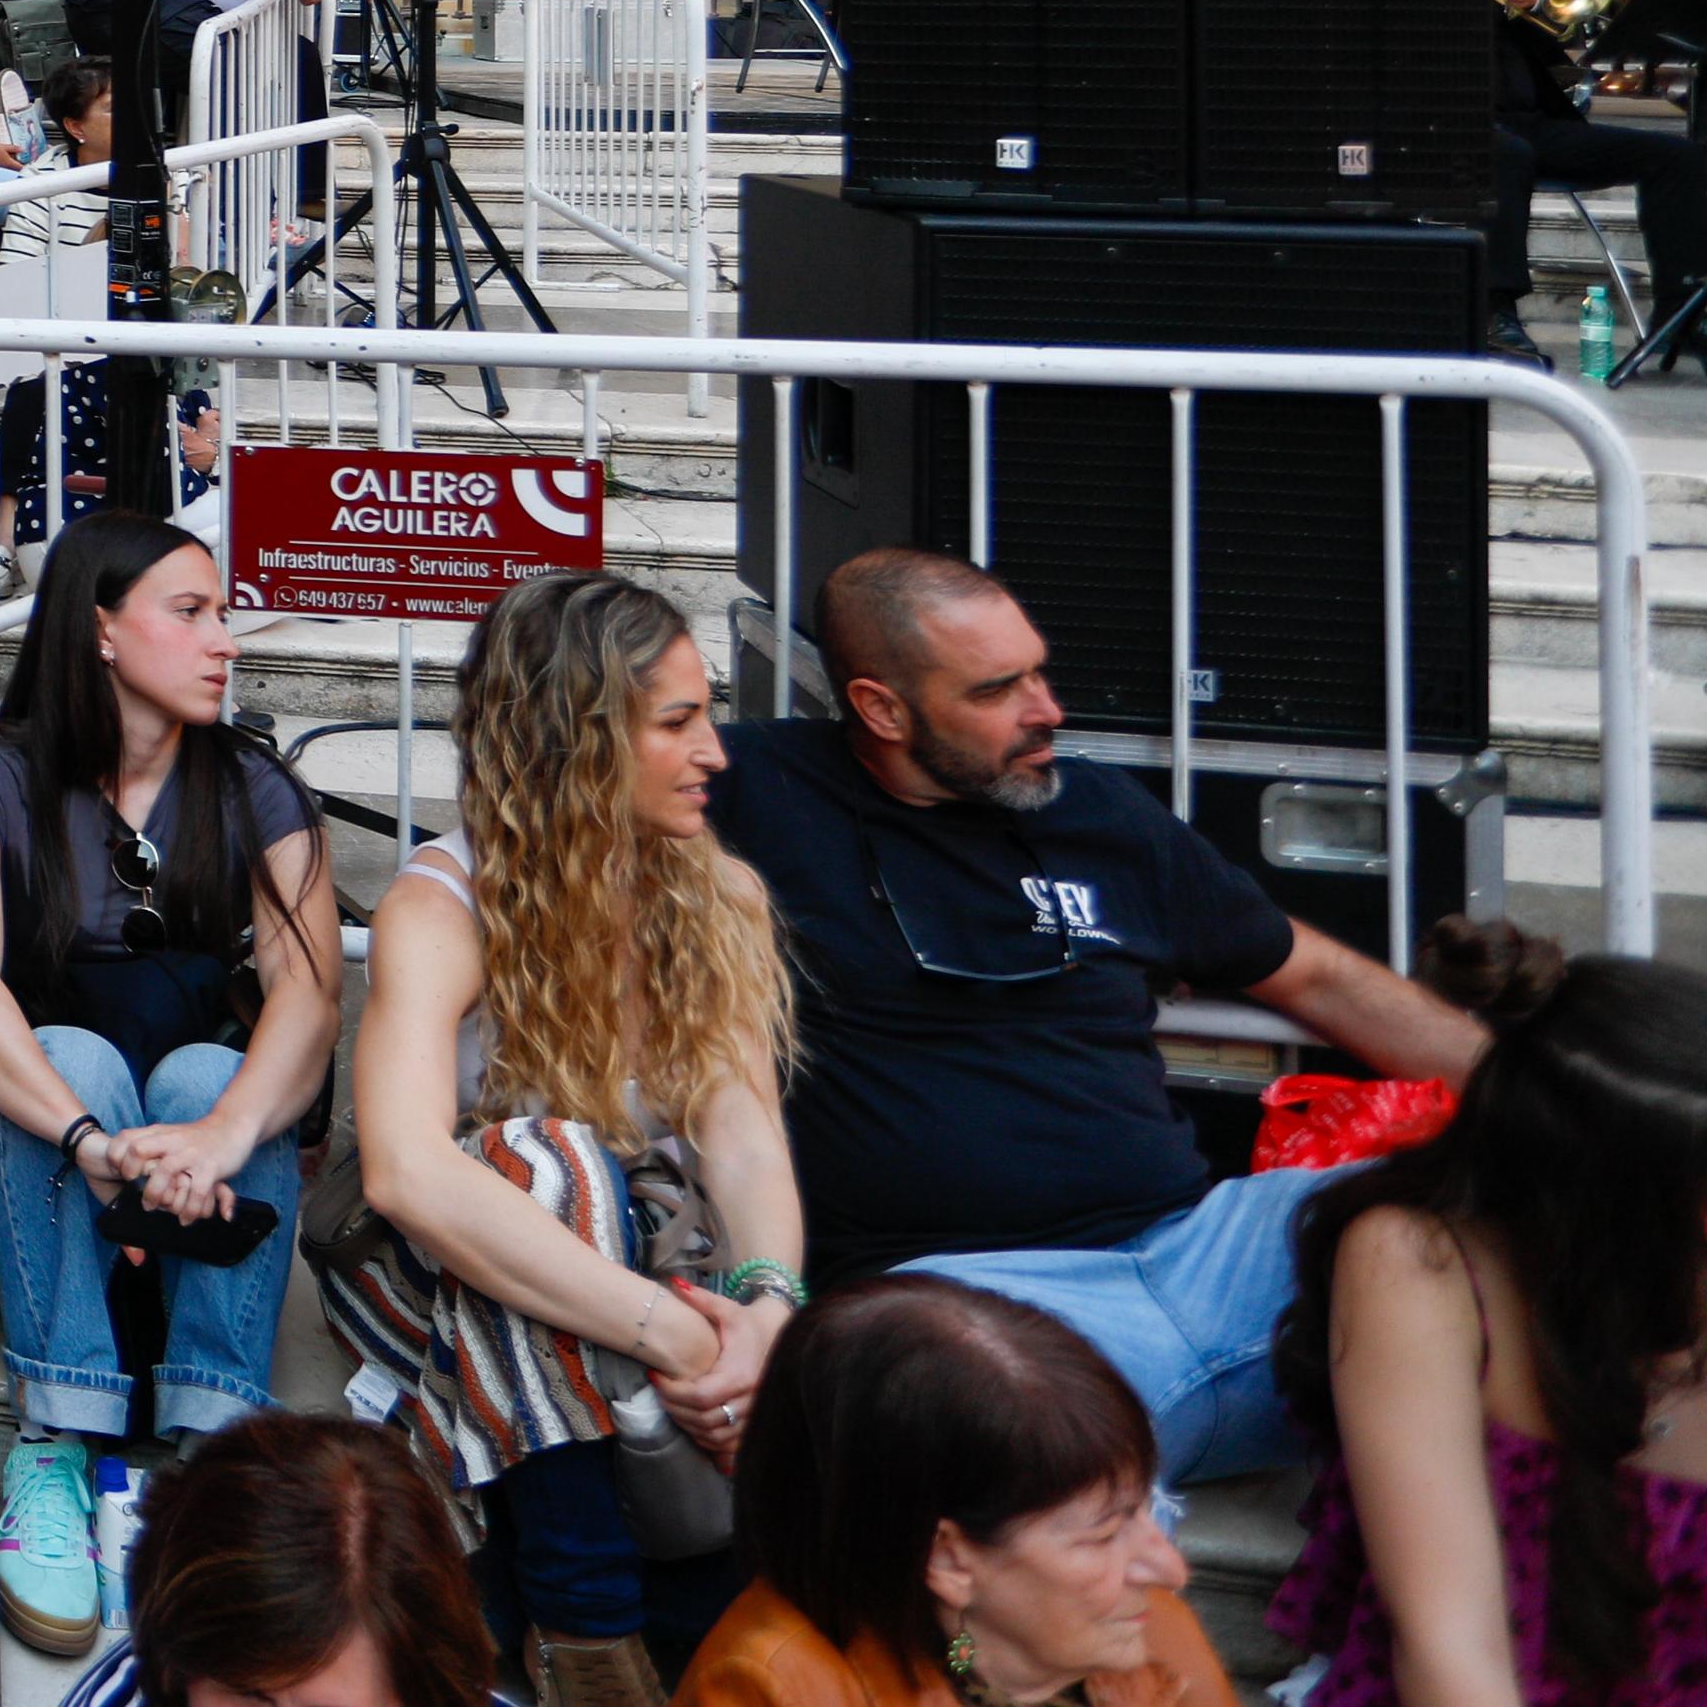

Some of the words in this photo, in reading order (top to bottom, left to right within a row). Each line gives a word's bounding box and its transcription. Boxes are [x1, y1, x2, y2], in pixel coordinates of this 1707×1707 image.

[999, 143, 1025, 160] HK
[1342, 149, 1365, 166] HK
[330, 466, 497, 507] CALERO
[331, 506, 497, 539] AGUILERA
[258, 547, 396, 575] Infraestructuras
[409, 554, 489, 579] Servicios
[503, 559, 571, 580] Event
[298, 591, 326, 610] 649
[328, 592, 353, 611] 437
[405, 597, 491, 615] www.caler
[1020, 877, 1095, 926] OEY
